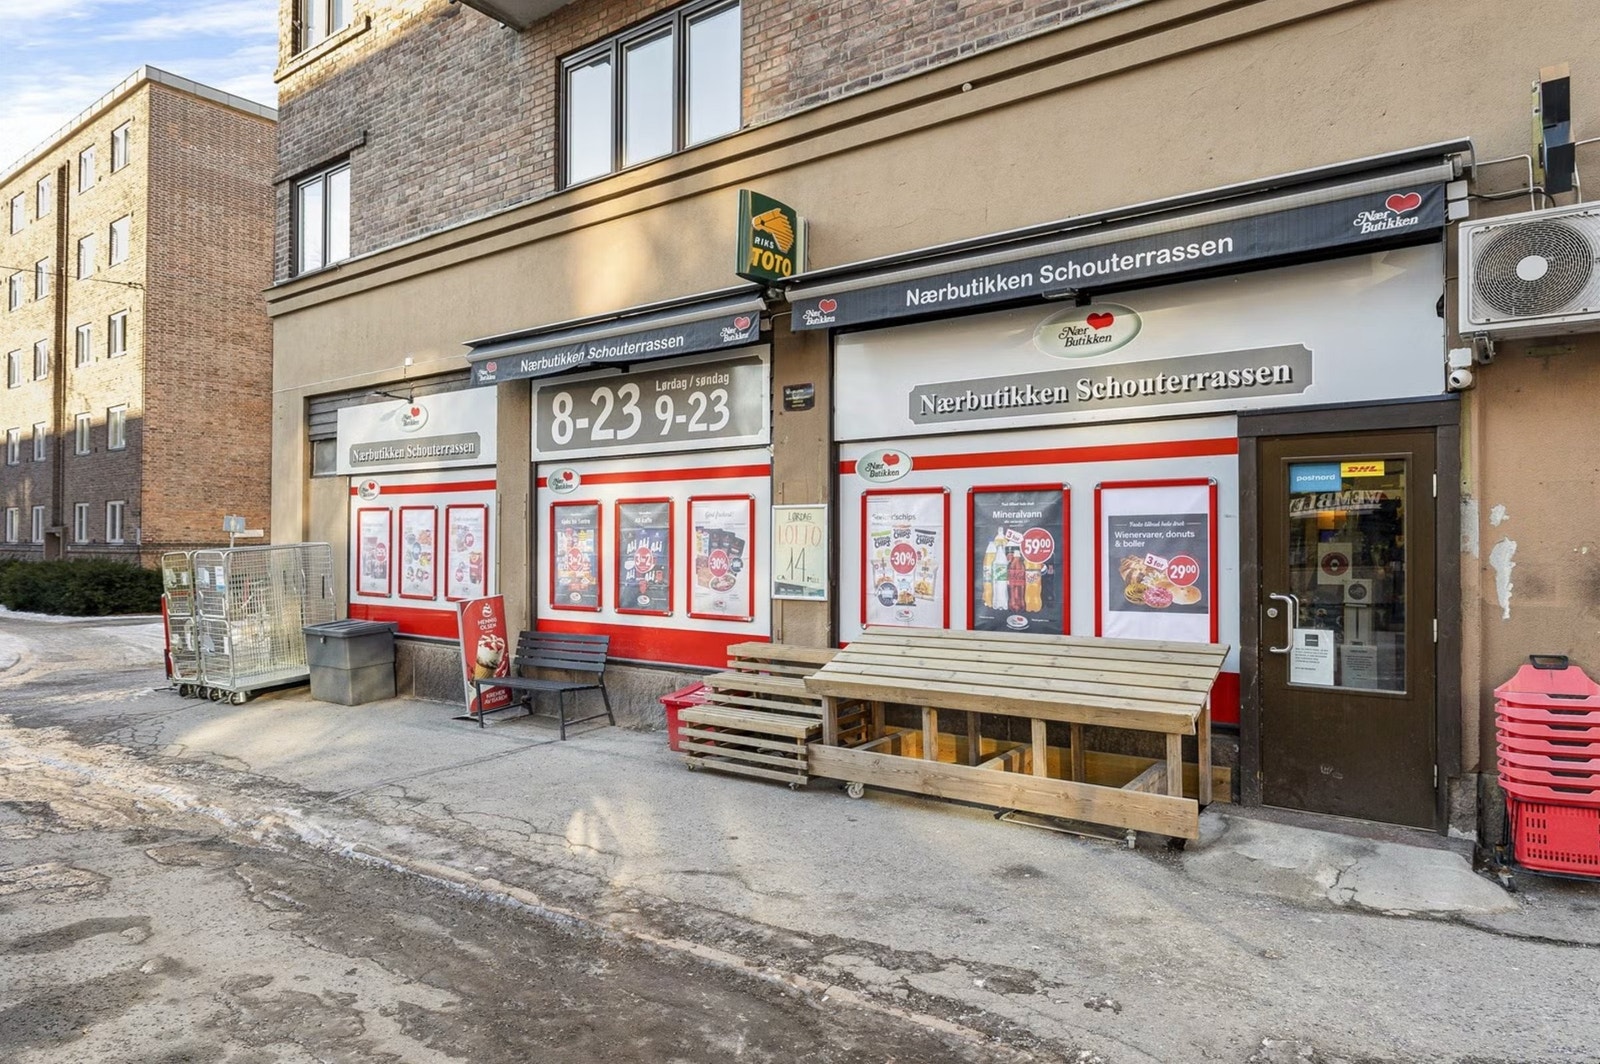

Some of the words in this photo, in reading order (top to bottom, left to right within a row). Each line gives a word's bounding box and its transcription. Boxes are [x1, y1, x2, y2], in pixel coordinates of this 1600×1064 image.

[1353, 210, 1390, 226] Nær
[1360, 216, 1419, 234] Butikken
[754, 236, 774, 249] RIKS
[752, 247, 792, 277] TOTO
[905, 270, 1033, 307] Nærbutikken
[1039, 235, 1234, 284] Schouterrassen
[1058, 326, 1090, 339] Nær
[1065, 334, 1113, 347] Butikken
[520, 351, 585, 373] Nærbutikken
[587, 334, 684, 360] Schouterrassen
[656, 376, 687, 392] Lørdag
[689, 374, 694, 387] /
[696, 372, 729, 387] søndag
[920, 381, 1068, 415] Nærbutikken
[1076, 362, 1293, 402] Schouterrassen
[551, 383, 642, 445] 8-23
[655, 388, 730, 436] 9-23
[352, 444, 405, 463] Nærbutikken
[407, 441, 476, 459] Schouterrassen
[870, 469, 899, 478] Butikken
[1347, 465, 1378, 473] DHL
[1296, 474, 1336, 482] postnord
[992, 510, 1042, 519] Mineralvann
[1007, 531, 1012, 539] 3
[1114, 531, 1164, 539] Wienervarer,
[1166, 530, 1195, 538] donuts
[635, 553, 640, 566] 3
[645, 553, 651, 566] 2
[786, 547, 806, 582] 14
[891, 552, 915, 566] -30%
[1146, 556, 1153, 564] 3
